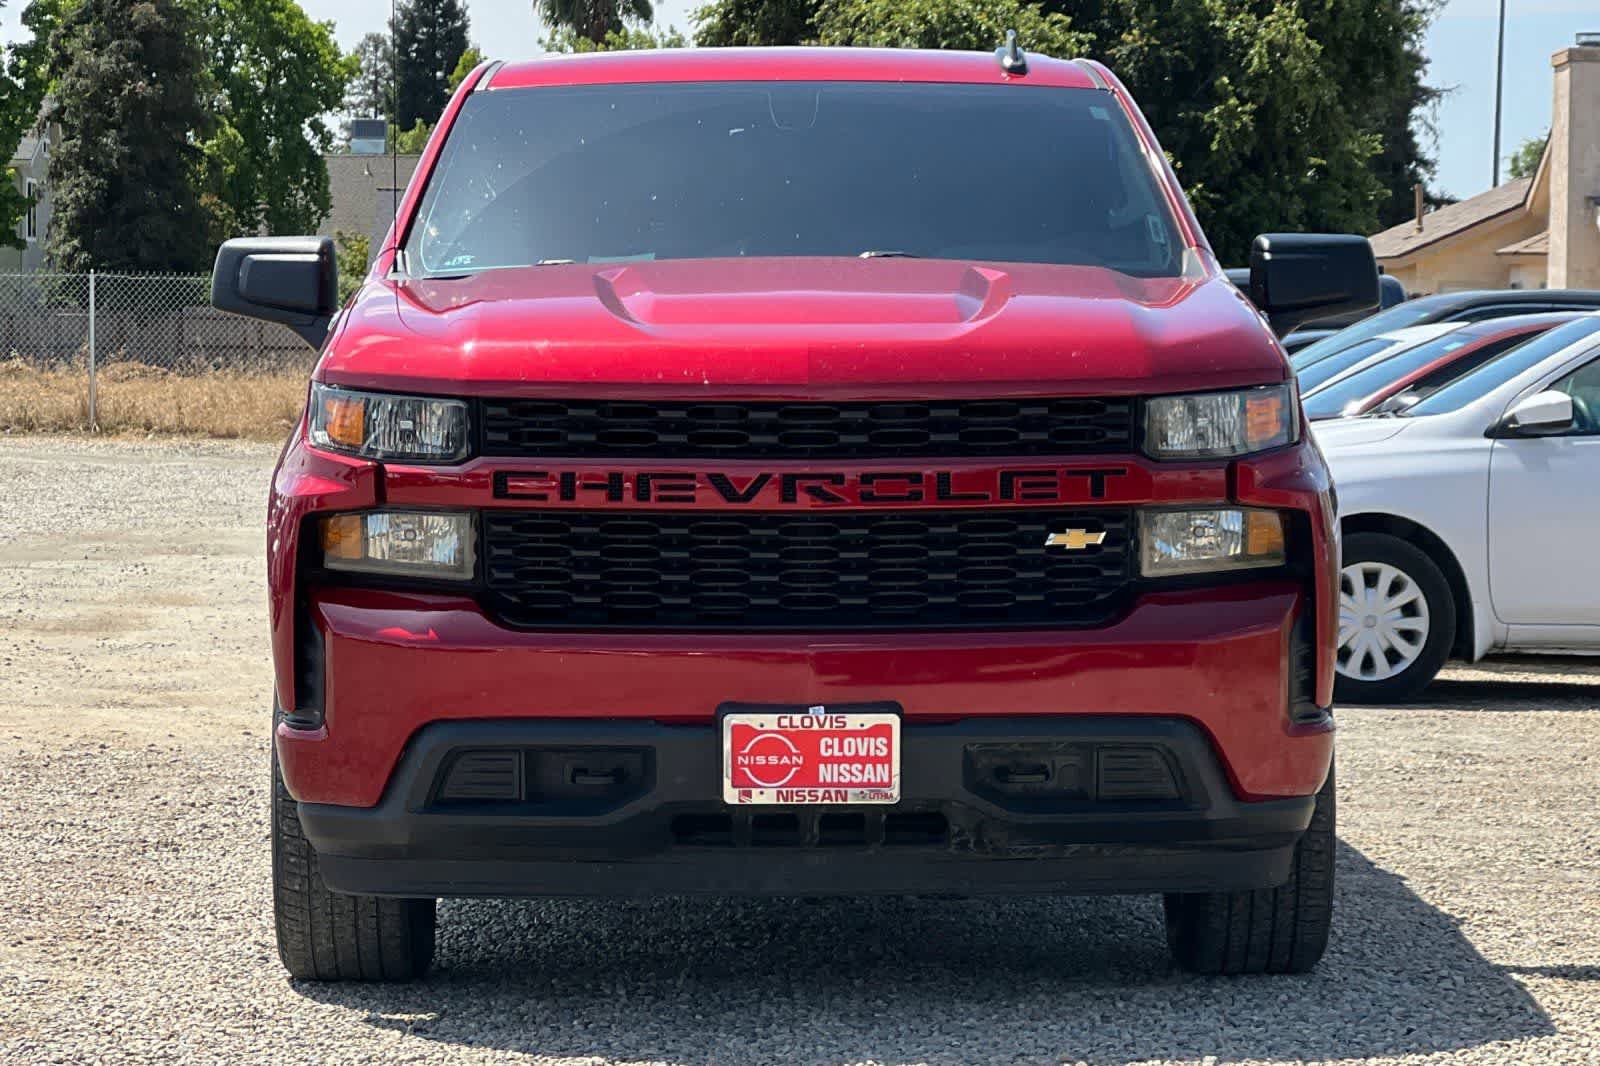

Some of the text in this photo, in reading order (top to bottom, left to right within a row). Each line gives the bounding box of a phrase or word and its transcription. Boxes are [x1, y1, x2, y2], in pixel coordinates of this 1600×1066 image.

[492, 469, 1127, 503] CHEVROLET
[777, 715, 847, 728] CLOVIS
[819, 737, 888, 757] CLOVIS
[737, 756, 804, 765] NISSAN
[818, 763, 889, 783] NISSAN
[776, 789, 848, 802] NISSAN
